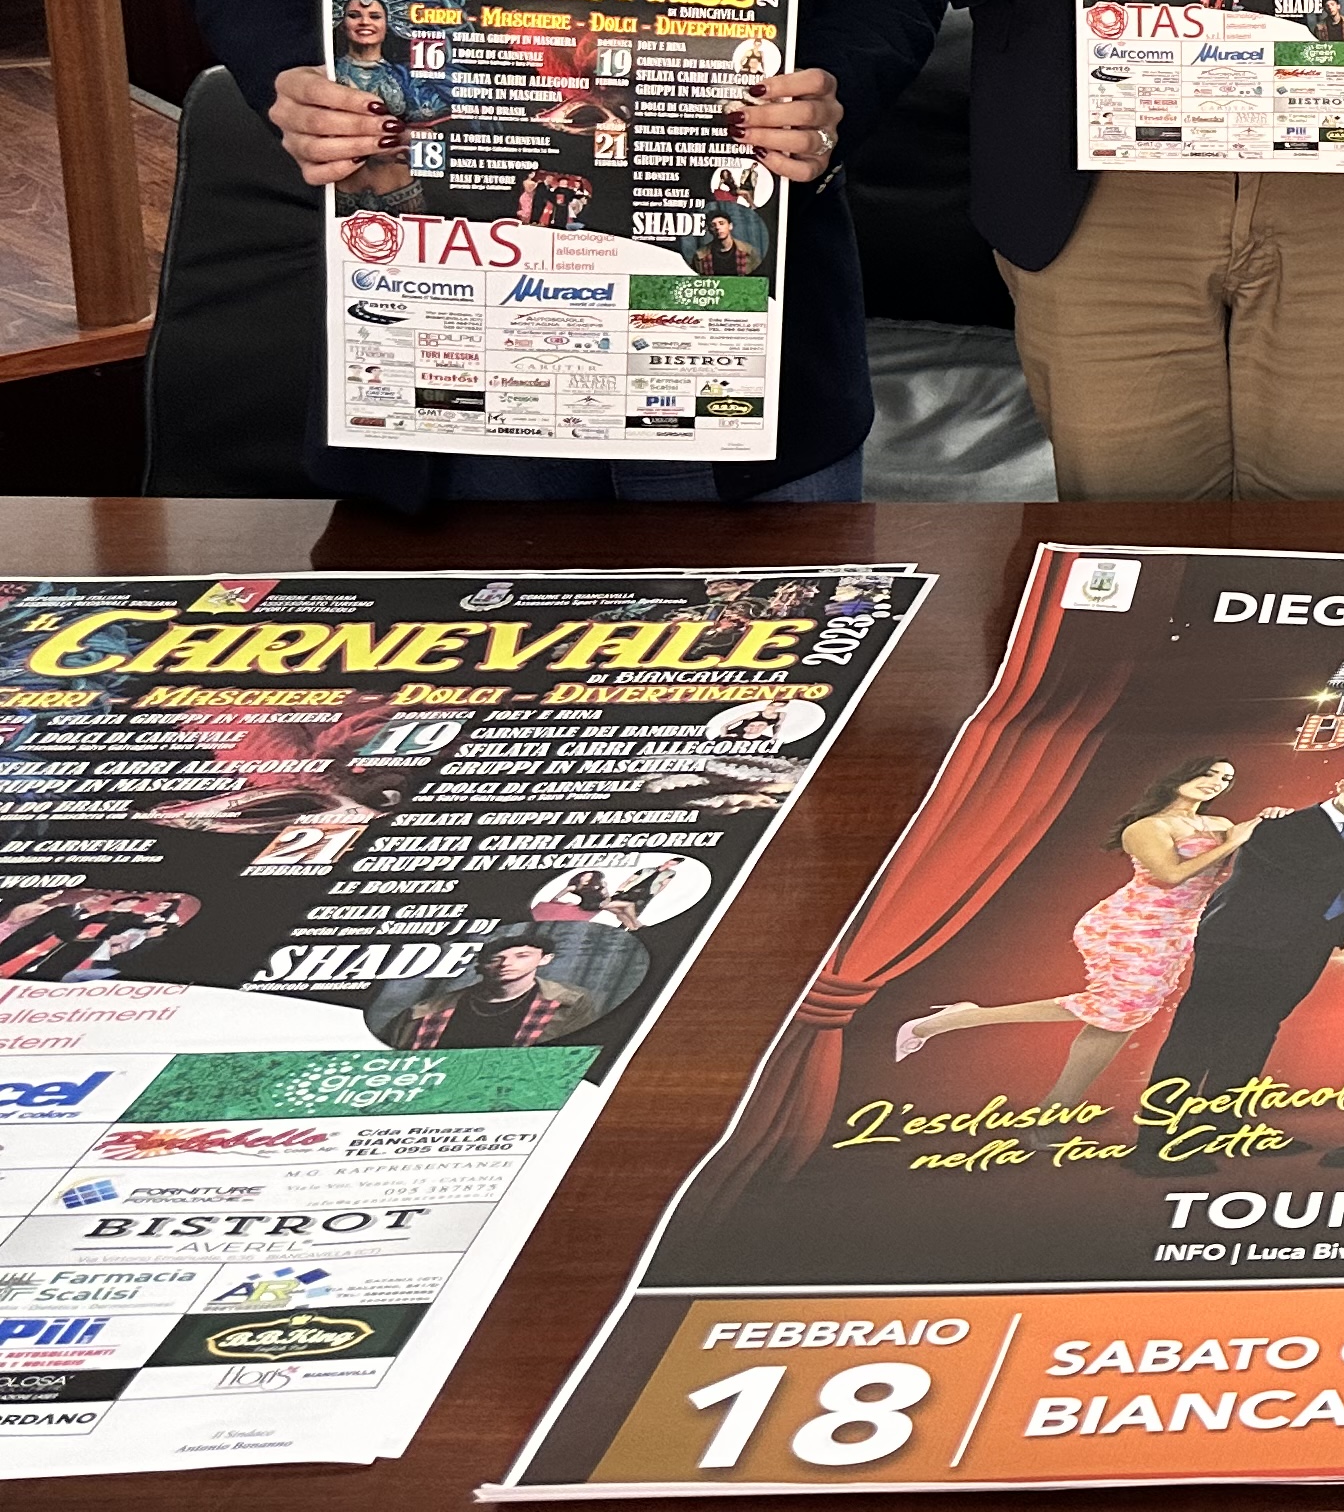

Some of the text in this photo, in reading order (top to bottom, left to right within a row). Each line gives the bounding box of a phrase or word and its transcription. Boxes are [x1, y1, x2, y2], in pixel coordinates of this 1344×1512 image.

[410, 3, 777, 40] CARRI MASCHERE DOLCI DIVERTIMENTO
[679, 7, 755, 21] BIANCAVILLA
[411, 39, 446, 71] 16
[598, 48, 633, 78] 19
[1109, 46, 1174, 60] Aircomm
[1195, 42, 1265, 63] Muracel
[410, 141, 446, 170] 18
[594, 131, 627, 161] 21
[632, 212, 706, 238] SHADE
[376, 277, 474, 298] Aircomm
[499, 274, 615, 305] Muracel
[648, 355, 748, 367] BISTROT
[28, 607, 818, 678] CARNEVALE
[614, 671, 789, 684] BIANCAVILLA
[142, 682, 833, 708] MASCHERE DOLCI DIVERTIMENTO
[483, 710, 603, 721] JOEY RINA
[379, 721, 462, 756] 19
[470, 726, 581, 740] CARNEVALE
[584, 726, 617, 738] DEI
[260, 825, 357, 866] 21
[369, 831, 724, 853] SFILATA CARRI ALLEGORICI
[352, 851, 641, 873] GRUPPI IN MASCHERA
[327, 878, 460, 897] LE BONITAS
[305, 902, 469, 922] CECILIA GAYLE
[253, 941, 486, 982] SHADE
[362, 1055, 450, 1074] city
[325, 1072, 448, 1092] green
[331, 1087, 426, 1109] light
[832, 1095, 1114, 1151] L'esclusivo
[344, 1144, 389, 1158] TEL.
[394, 1143, 439, 1156] 095
[348, 1132, 538, 1147] BIANCAVILLA (CT)
[909, 1138, 1038, 1171] nella
[1051, 1136, 1139, 1167] tua
[84, 1208, 429, 1239] BISTROT
[176, 1240, 301, 1253] AVEREL
[1154, 1244, 1226, 1262] INFO
[1247, 1243, 1306, 1260] Luca
[49, 1270, 197, 1285] Farmacia
[34, 1286, 141, 1302] Scalisi
[701, 1318, 970, 1350] FEBBRAIO
[1046, 1336, 1321, 1377] SABATO
[688, 1362, 932, 1469] 18
